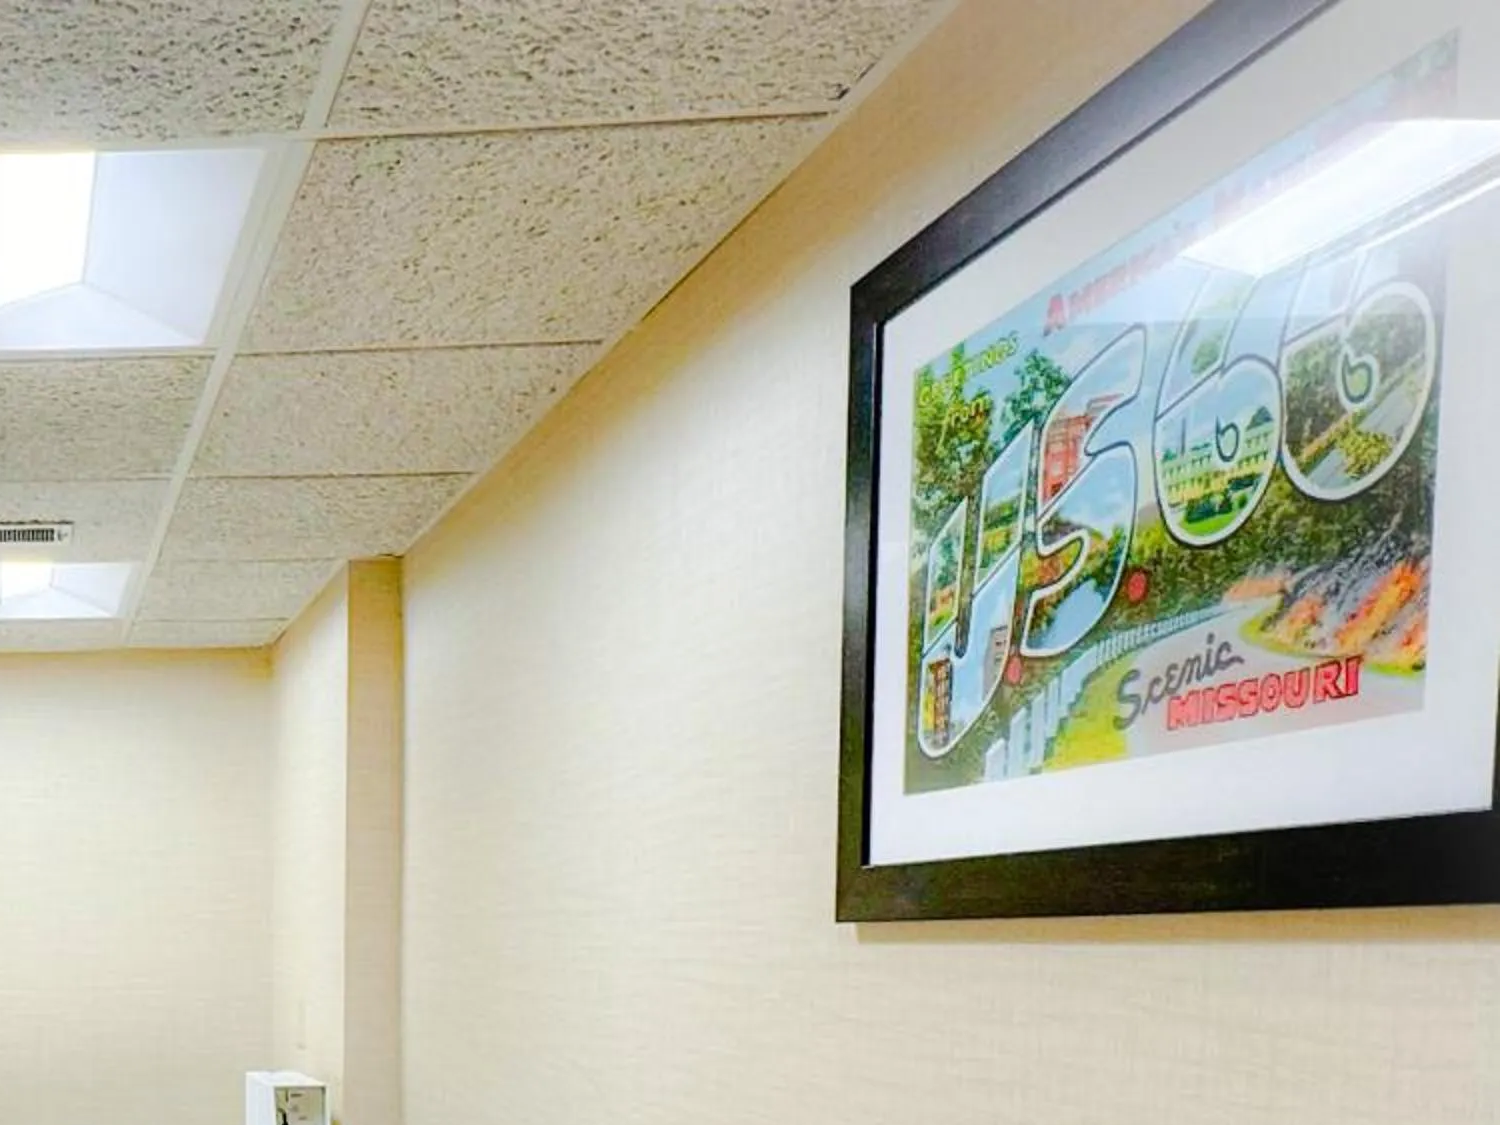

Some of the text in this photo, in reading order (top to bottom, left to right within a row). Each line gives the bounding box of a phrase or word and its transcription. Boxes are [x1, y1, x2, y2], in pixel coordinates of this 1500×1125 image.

[1152, 235, 1437, 547] 66
[1113, 632, 1245, 731] Scenic
[1166, 655, 1364, 731] MISSOURI
